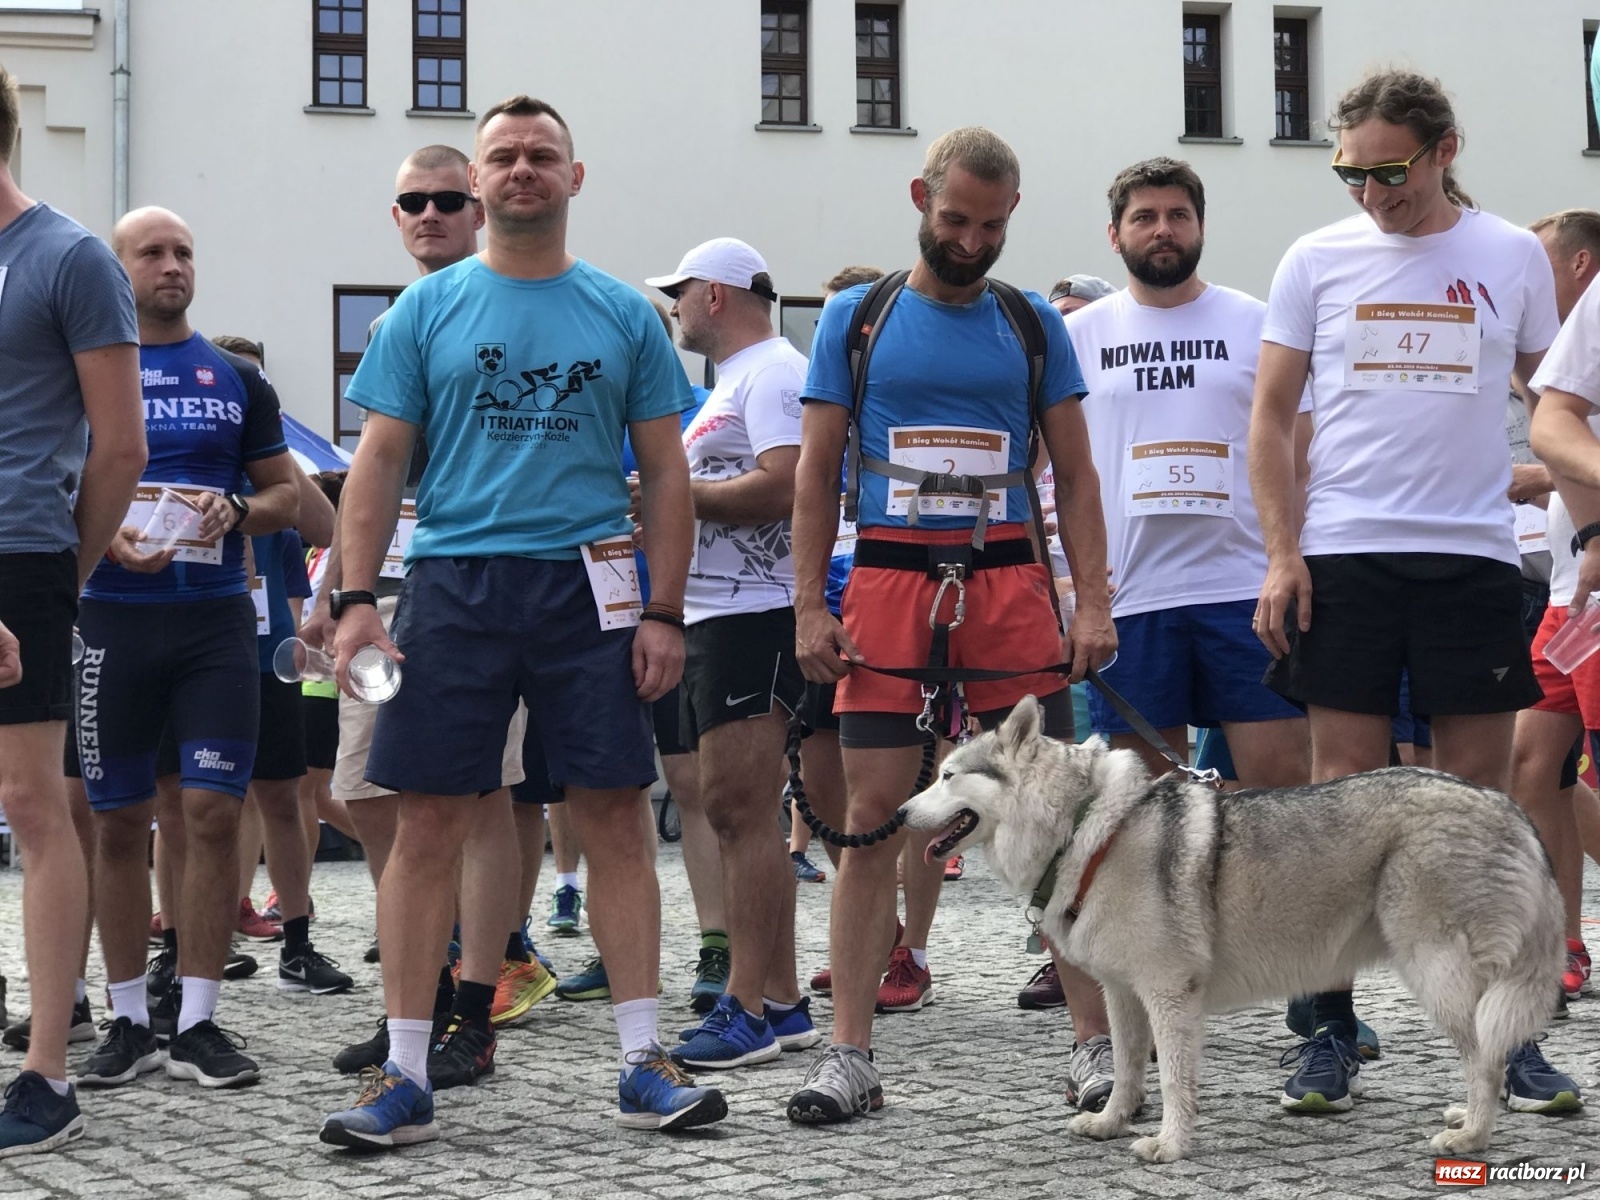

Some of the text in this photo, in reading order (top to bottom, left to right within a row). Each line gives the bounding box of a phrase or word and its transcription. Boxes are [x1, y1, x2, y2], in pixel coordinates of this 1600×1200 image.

[1376, 309, 1395, 319] Bieg
[1398, 309, 1424, 318] Wokół
[1427, 311, 1459, 320] Komina
[1397, 332, 1431, 354] 47
[1101, 340, 1229, 370] NOWA HUTA
[1134, 364, 1195, 391] TEAM
[181, 422, 217, 432] TEAM
[480, 416, 579, 432] I TRIATHLON
[487, 430, 570, 443] Kędzierzyn-Koźle
[912, 437, 930, 446] Bieg
[960, 438, 989, 447] Komina
[1168, 465, 1195, 483] 55
[136, 492, 152, 500] Bieg
[607, 548, 622, 557] Bieg
[81, 646, 105, 780] RUNNERS
